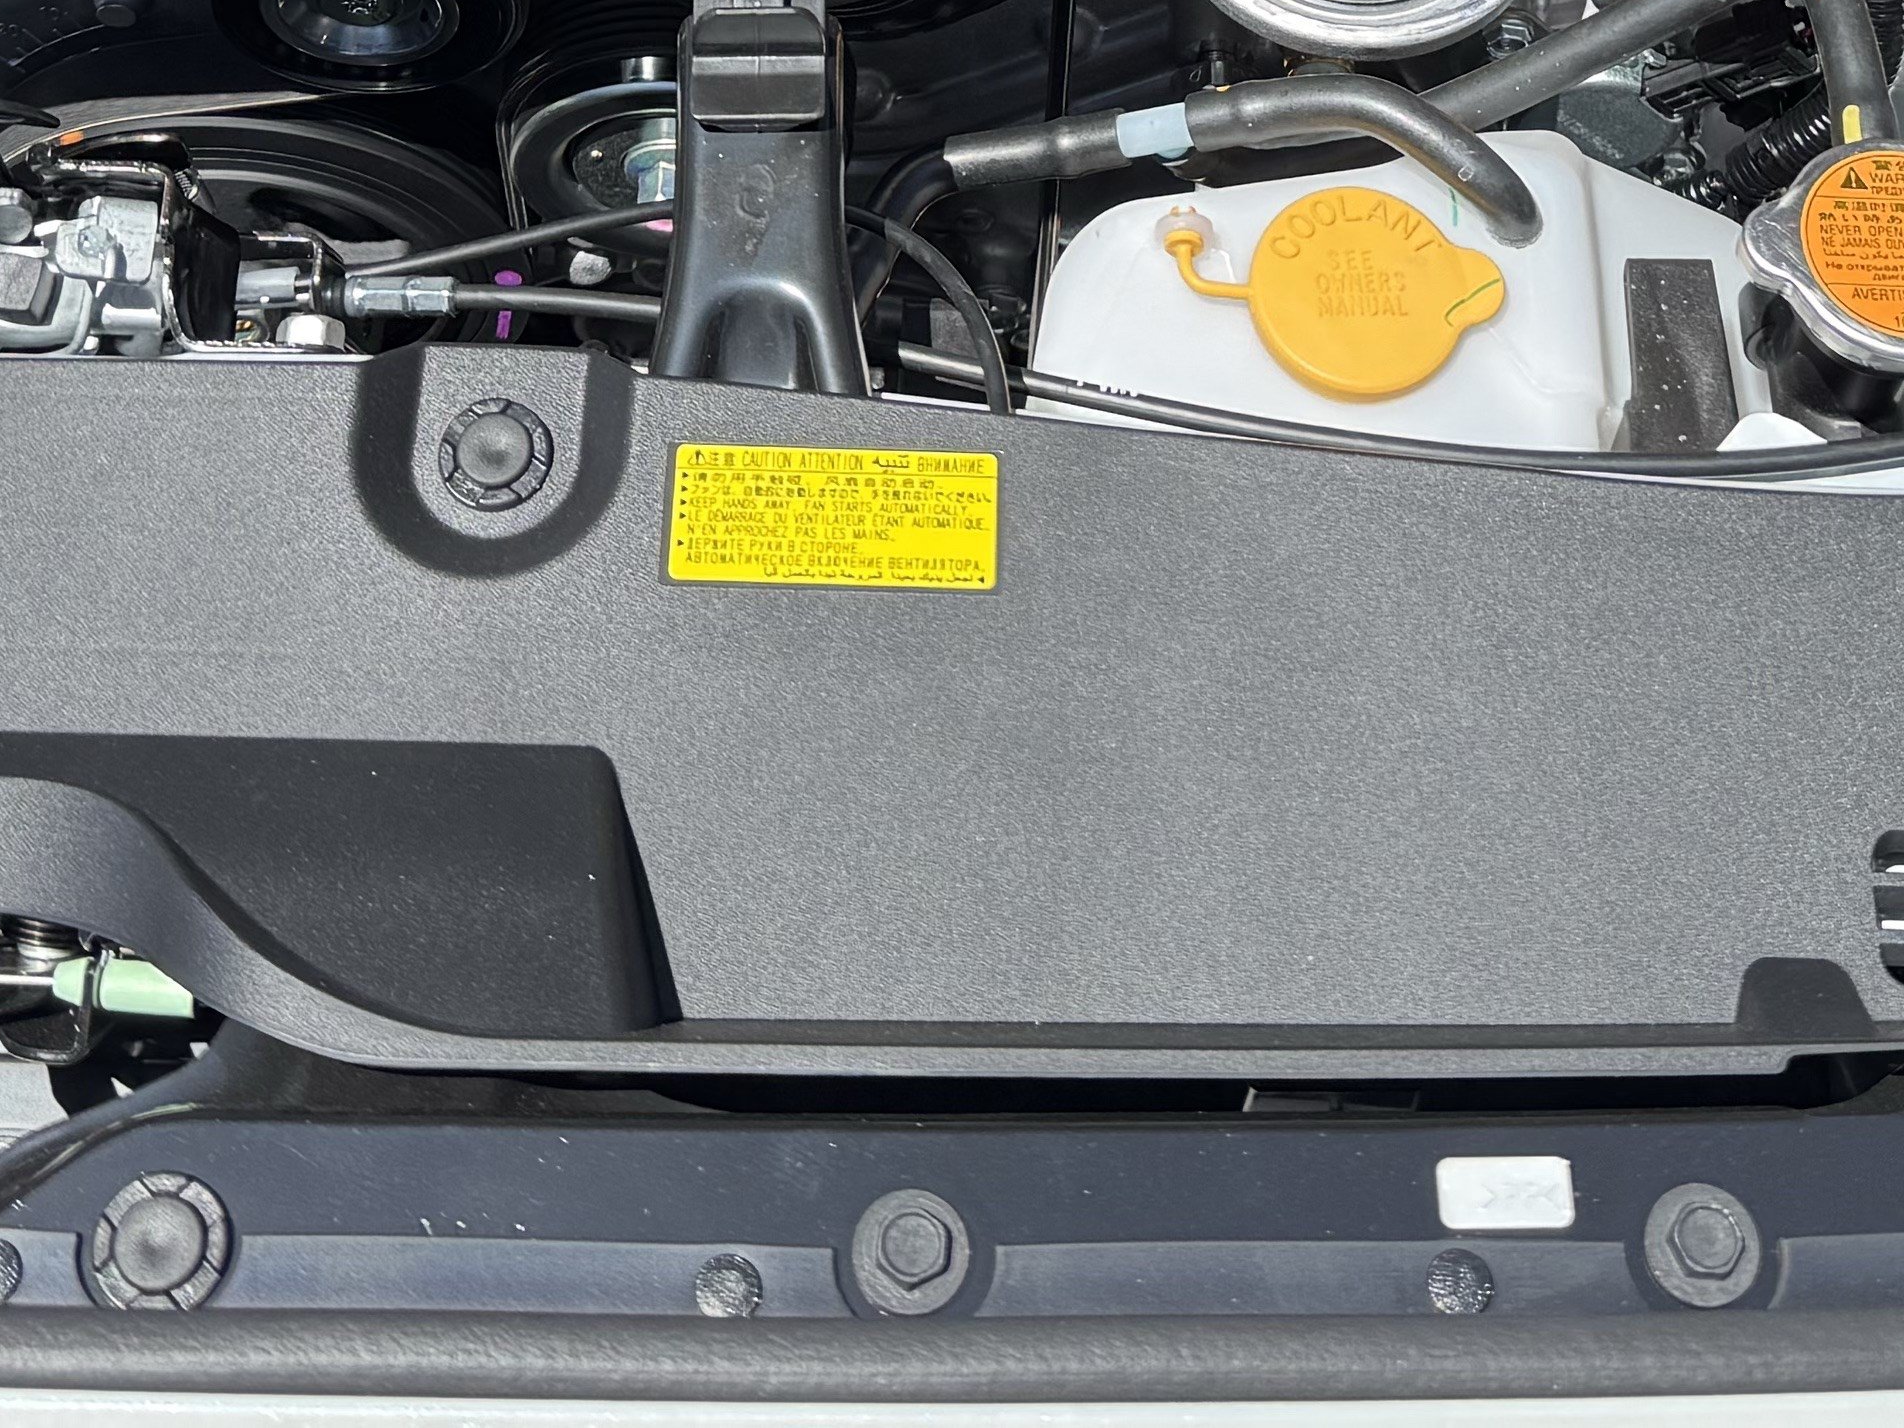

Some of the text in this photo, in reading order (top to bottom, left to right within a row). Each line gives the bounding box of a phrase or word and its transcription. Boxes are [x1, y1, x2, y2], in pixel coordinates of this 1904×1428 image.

[1269, 195, 1442, 260] COOLANT
[1820, 225, 1865, 236] NEVER
[1868, 226, 1903, 237] OPEN
[1821, 236, 1835, 247] NE
[1840, 237, 1880, 249] JAMAIS
[1327, 250, 1374, 270] SEE
[1316, 271, 1407, 294] OWNERS
[1318, 295, 1408, 317] MANUAL
[741, 451, 792, 469] CAUTION
[799, 452, 863, 471] ATTENTION
[917, 456, 984, 474] ВНИМАНИЕ
[688, 496, 718, 509] KEEP
[722, 497, 757, 509] HANDS
[804, 500, 825, 511] FAN
[832, 500, 873, 512] STARTS
[688, 510, 704, 521] LE
[773, 512, 787, 523] DU
[793, 512, 865, 526] VENTILATEUR
[723, 523, 788, 537] APPROCHEZ
[794, 527, 816, 537] PAS
[824, 527, 845, 539] LES
[787, 541, 796, 552] В
